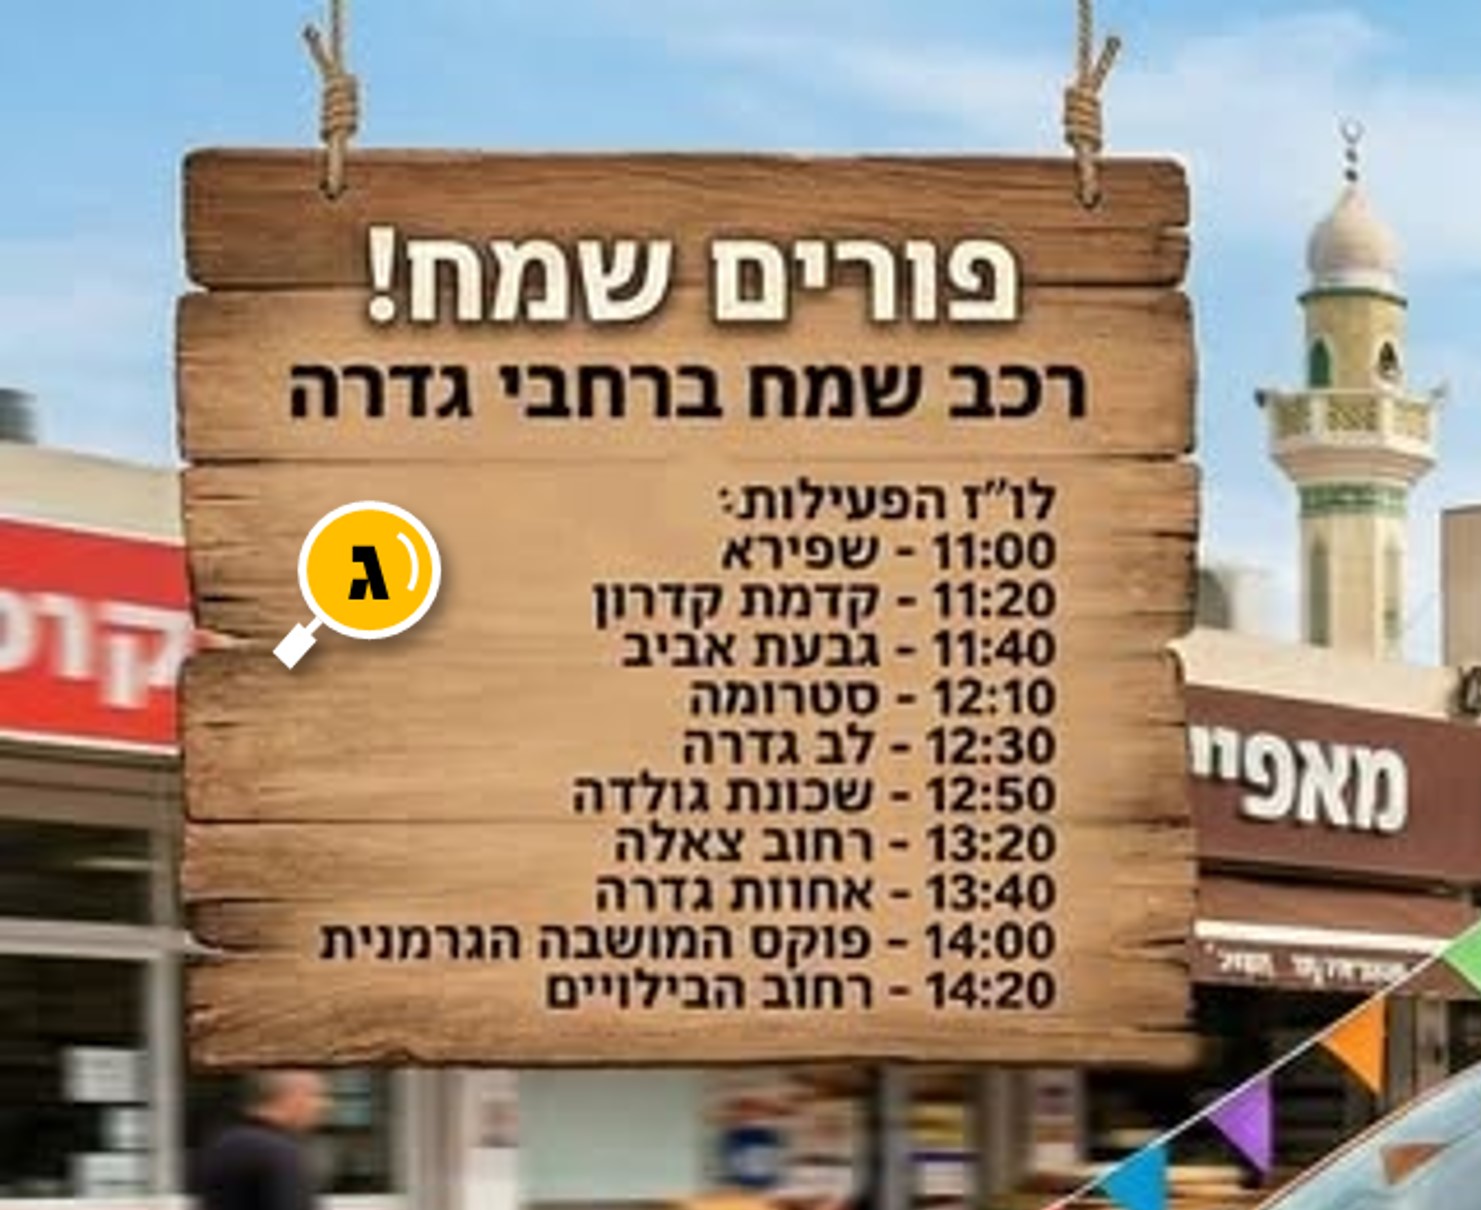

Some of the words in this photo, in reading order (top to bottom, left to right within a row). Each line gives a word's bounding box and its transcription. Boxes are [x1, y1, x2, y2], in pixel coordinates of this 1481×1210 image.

[368, 226, 672, 323] שמח!
[711, 239, 1018, 322] פורים
[290, 363, 473, 419] גדרה
[499, 363, 723, 419] ברחבי
[749, 363, 924, 419] שמח
[949, 363, 1087, 419] רכב
[721, 534, 880, 571] שפירא
[933, 531, 1057, 571] 11:00
[593, 583, 723, 629] קדרון
[739, 583, 880, 629] קדמת
[933, 579, 1057, 619] 11:20
[622, 632, 736, 668] אביב
[753, 632, 881, 669] גבעת
[933, 628, 1057, 668] 11:40
[690, 680, 880, 717] סטרומה
[933, 676, 1057, 717] 12:10
[683, 729, 801, 765] גדרה
[816, 721, 876, 765] לב
[926, 725, 1057, 766] 12:30
[573, 769, 710, 814] גולדה
[725, 777, 874, 814] שכונת
[926, 774, 1057, 815] 12:50
[615, 819, 745, 863] צאלה
[762, 827, 873, 863] רחוב
[927, 823, 1057, 863] 13:20
[596, 875, 714, 912] גדרה
[729, 876, 873, 912] אחוות
[927, 872, 1057, 913] 13:40
[319, 924, 521, 960] הגרמנית
[539, 924, 733, 960] המושבה
[751, 924, 872, 967] פוקס
[925, 921, 1057, 961] 14:00
[546, 967, 746, 1010] הבילויים
[762, 974, 873, 1010] רחוב
[925, 970, 1057, 1011] 14:20
